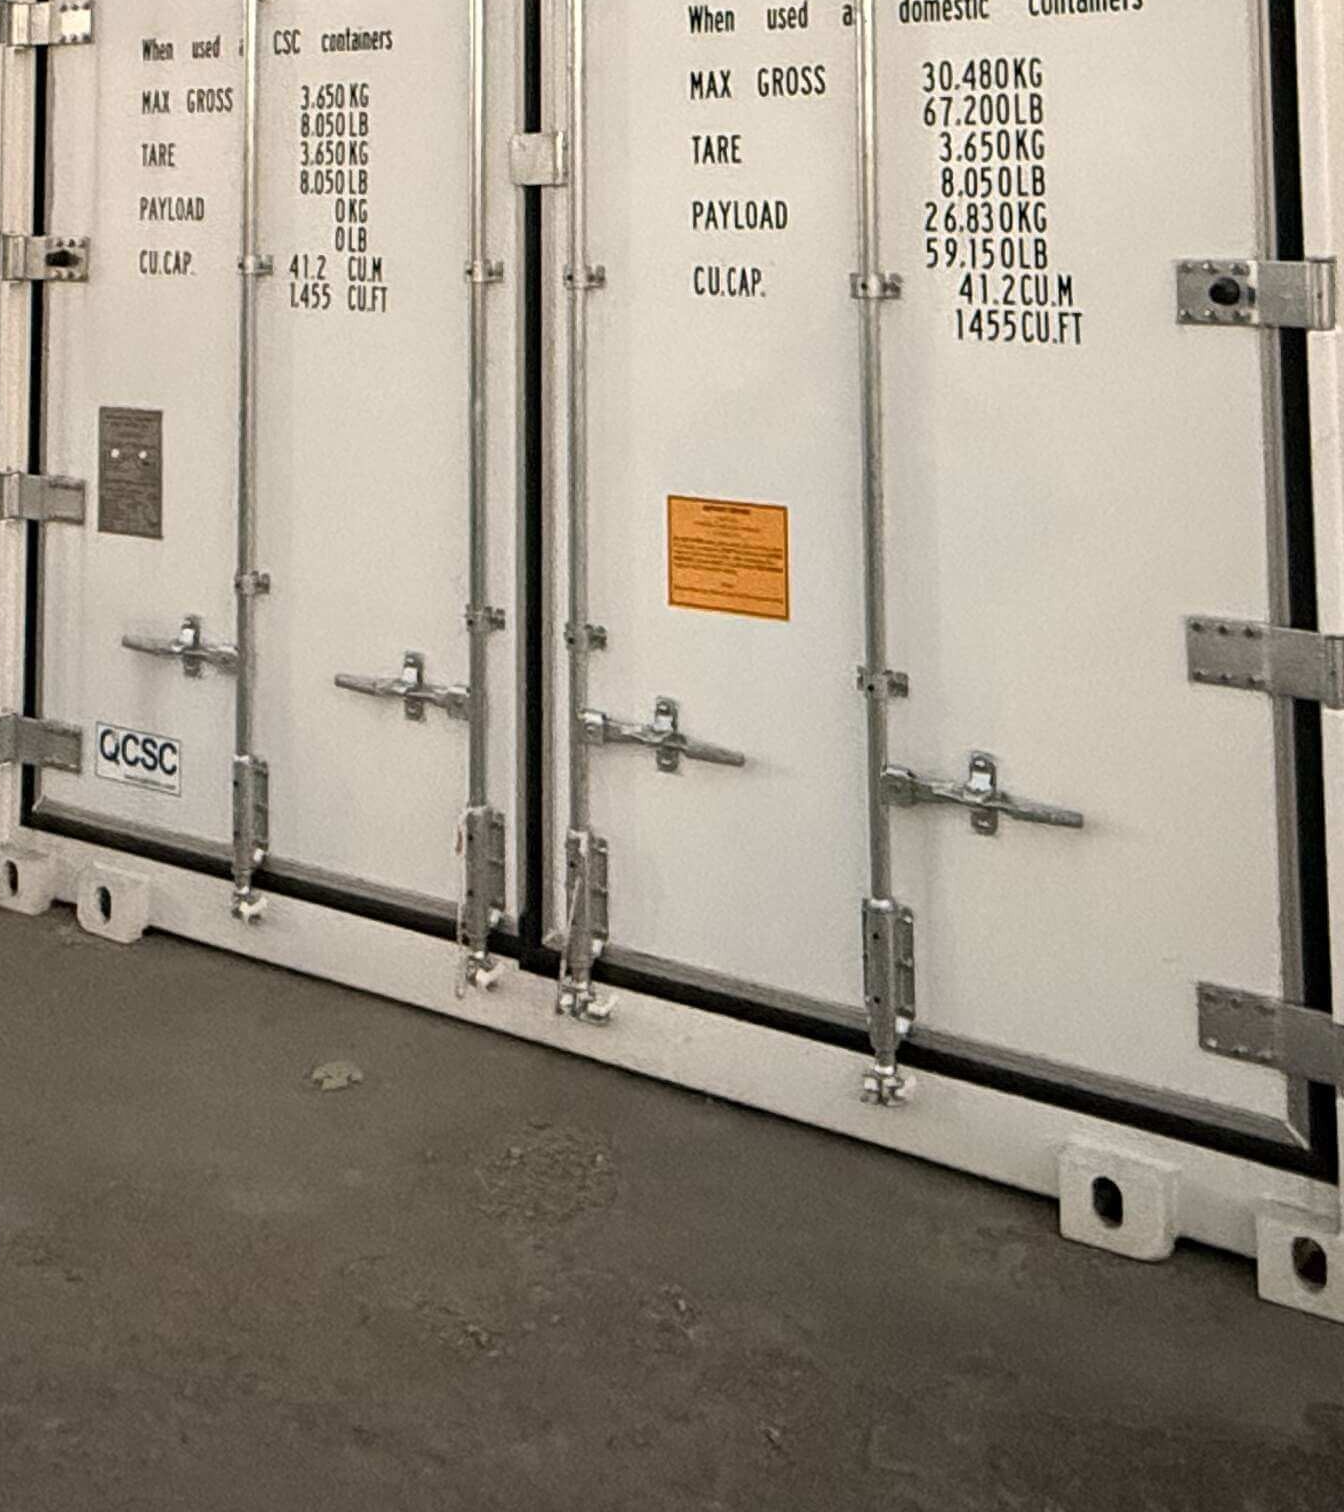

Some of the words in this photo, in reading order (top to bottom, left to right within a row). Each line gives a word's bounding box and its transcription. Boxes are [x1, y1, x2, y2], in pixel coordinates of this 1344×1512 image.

[687, 5, 735, 34] When
[767, 2, 808, 31] used
[842, 4, 856, 27] a
[191, 36, 221, 59] used
[274, 30, 301, 55] CSC
[321, 28, 392, 53] containers
[689, 72, 732, 100] MAX
[757, 66, 826, 97] GROSS
[142, 90, 170, 114] MAX
[187, 87, 233, 113] GROSS
[142, 143, 176, 167] TARE
[691, 136, 742, 165] TARE
[140, 196, 204, 221] PAYLOAD
[692, 201, 788, 230] PAYLOAD
[290, 254, 326, 280] 41.2
[99, 728, 178, 776] QCSC
